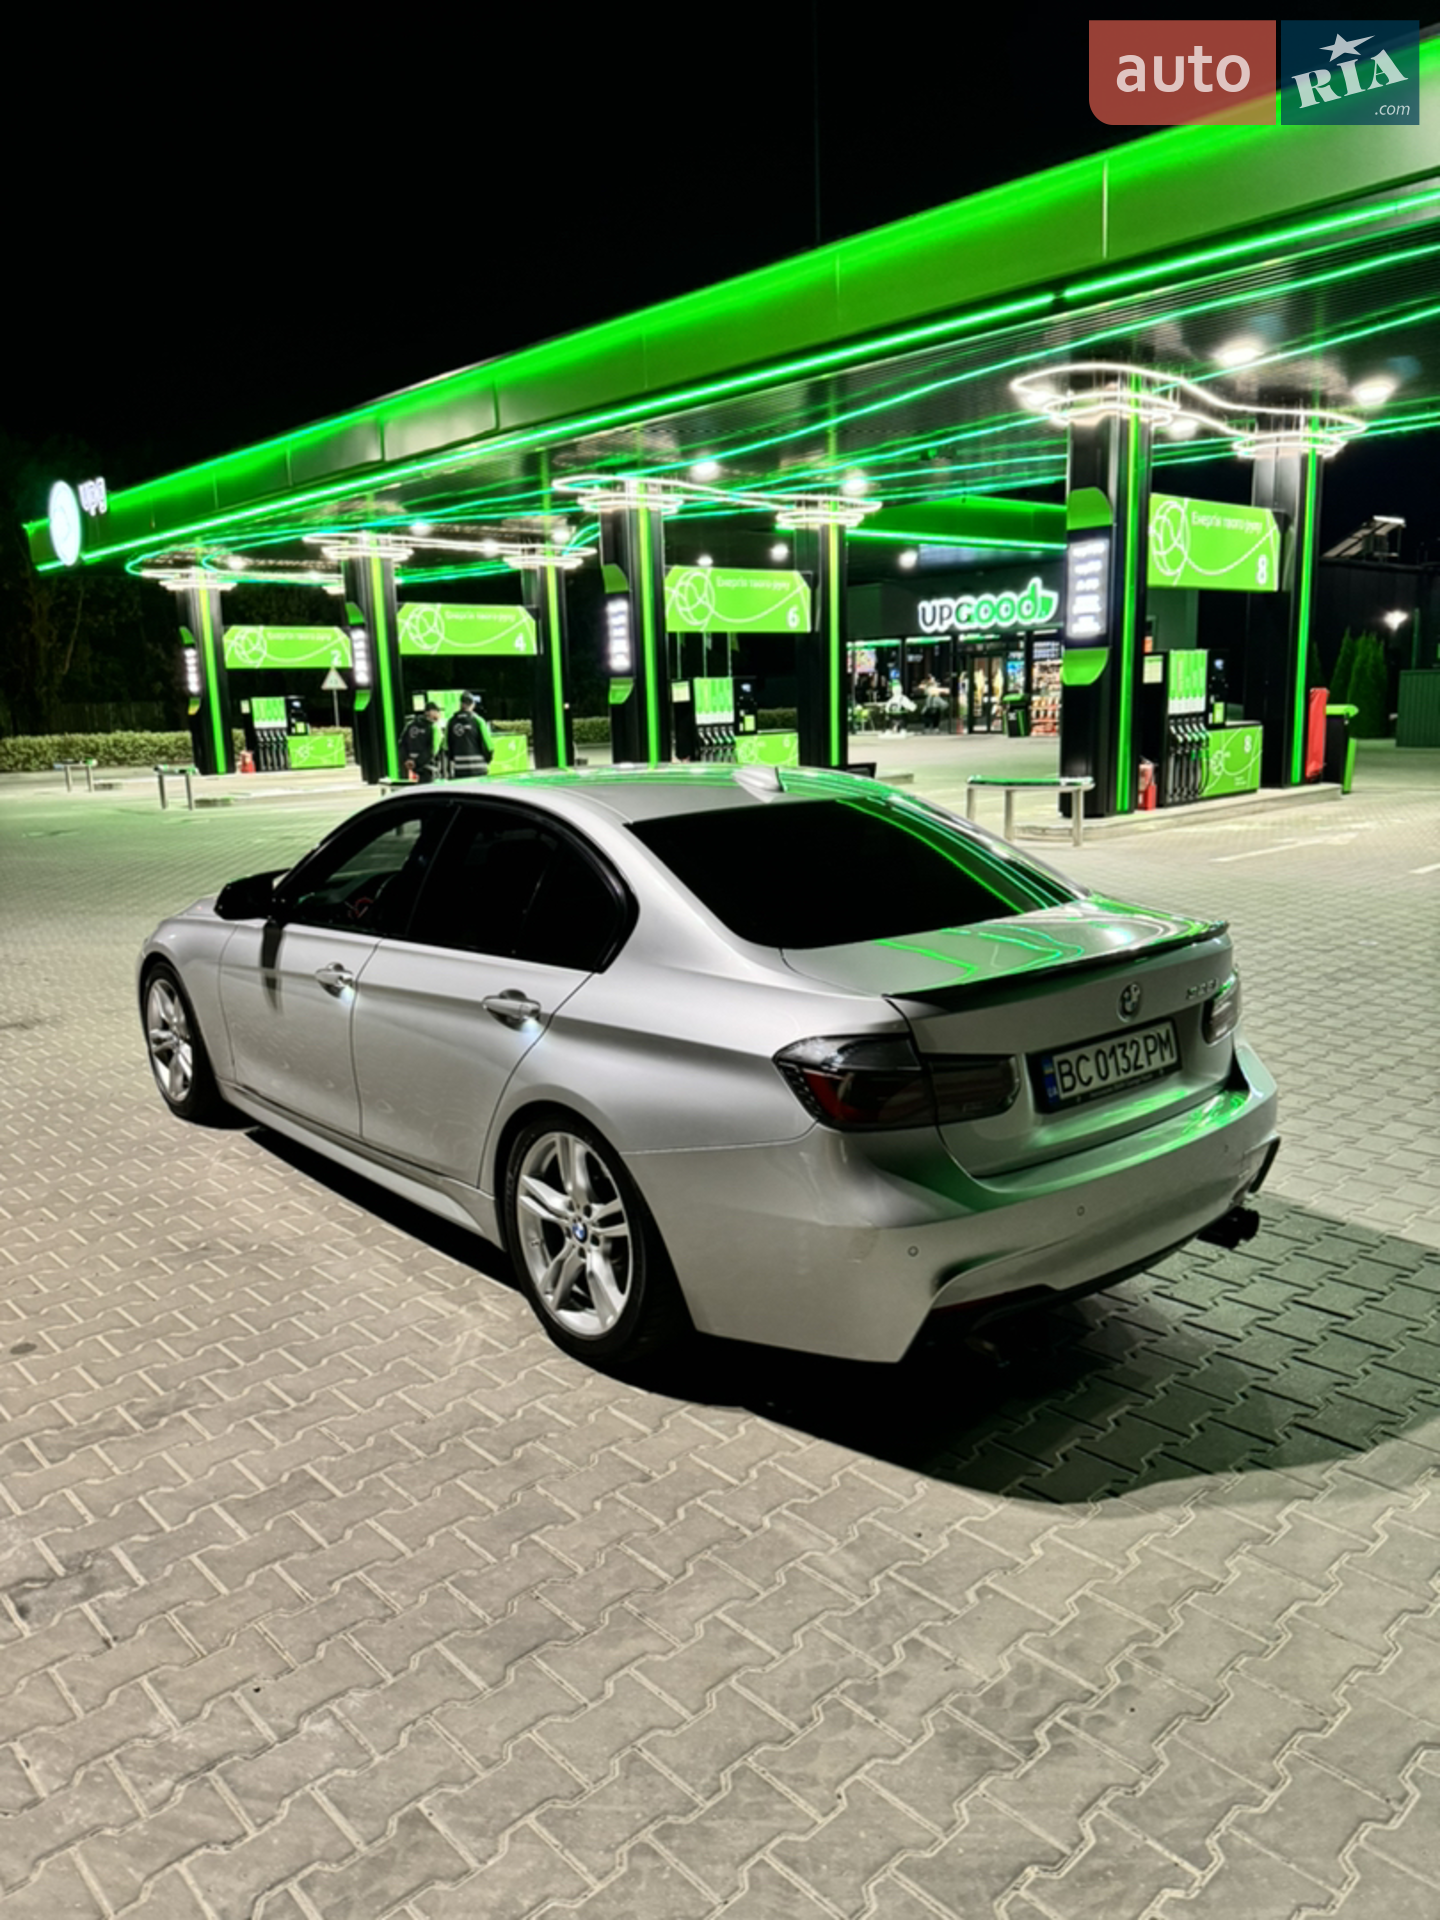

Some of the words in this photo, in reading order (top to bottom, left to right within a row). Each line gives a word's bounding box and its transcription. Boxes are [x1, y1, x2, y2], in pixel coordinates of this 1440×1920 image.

[1256, 554, 1268, 585] 8
[786, 605, 800, 629] 6
[514, 632, 527, 652] 4
[330, 649, 342, 666] 2
